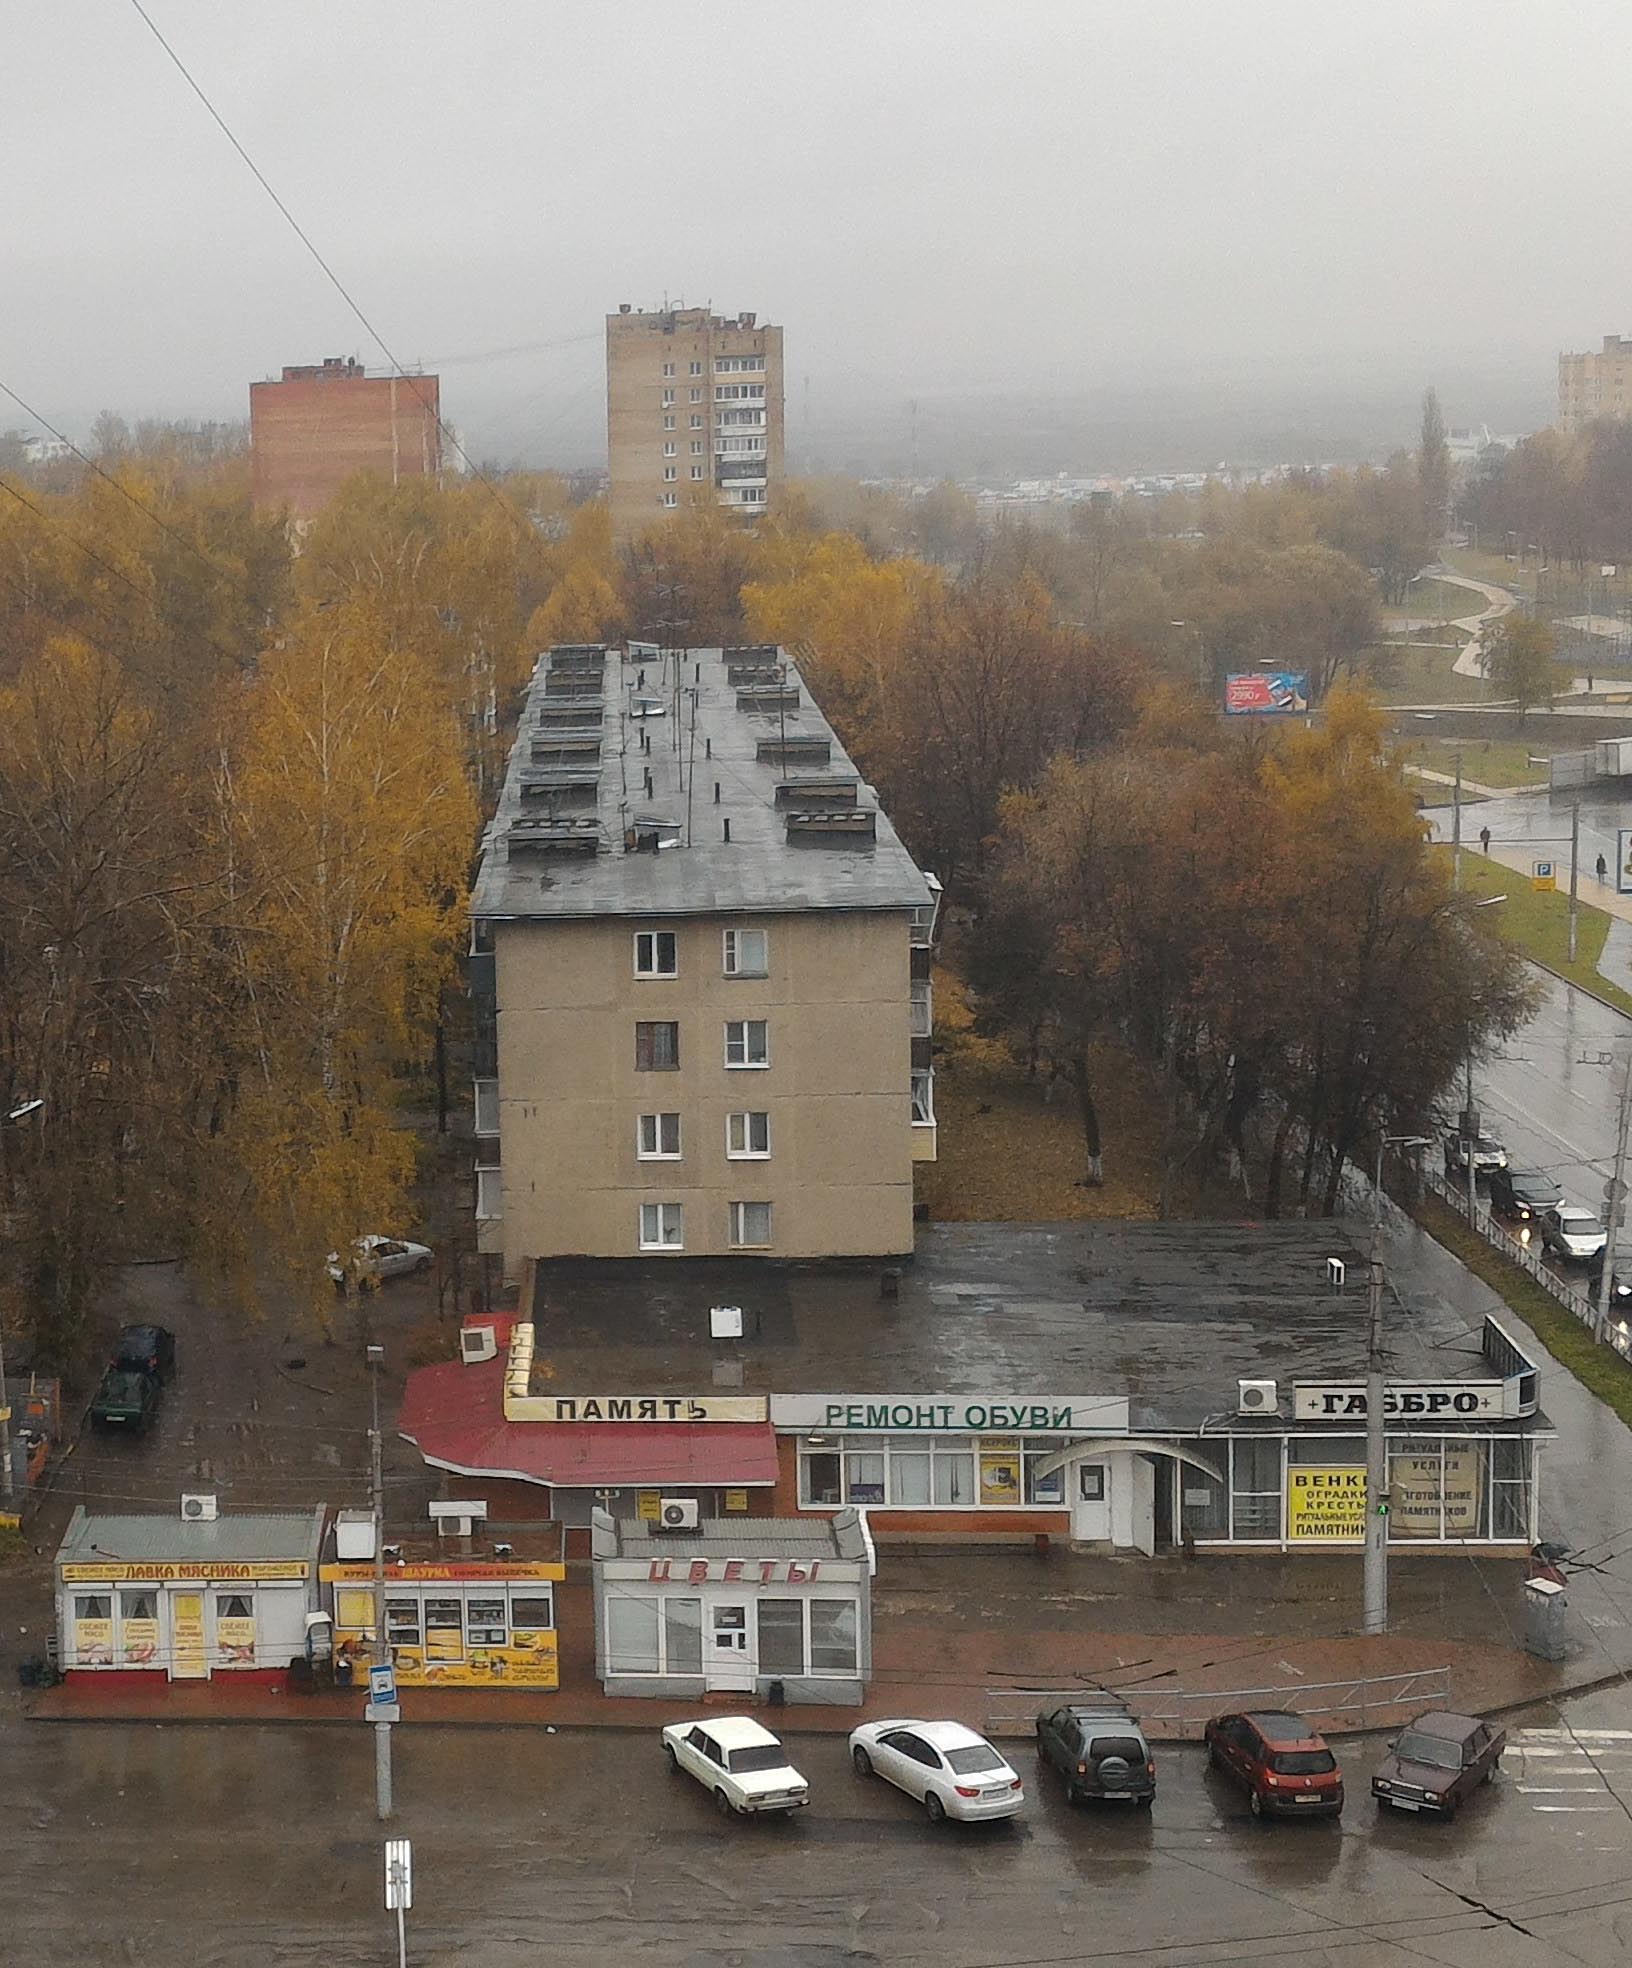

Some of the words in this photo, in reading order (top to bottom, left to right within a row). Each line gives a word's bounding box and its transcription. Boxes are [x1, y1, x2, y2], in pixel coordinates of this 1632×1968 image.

[556, 1400, 707, 1419] ПАМЯТЬ
[826, 1405, 955, 1428] РЕМОНТ
[965, 1406, 1072, 1429] ОБУВИ
[126, 1566, 174, 1578] ЛАВКА
[179, 1565, 250, 1577] МЯСНИКА
[649, 1557, 822, 1584] ЦВЕТЫ
